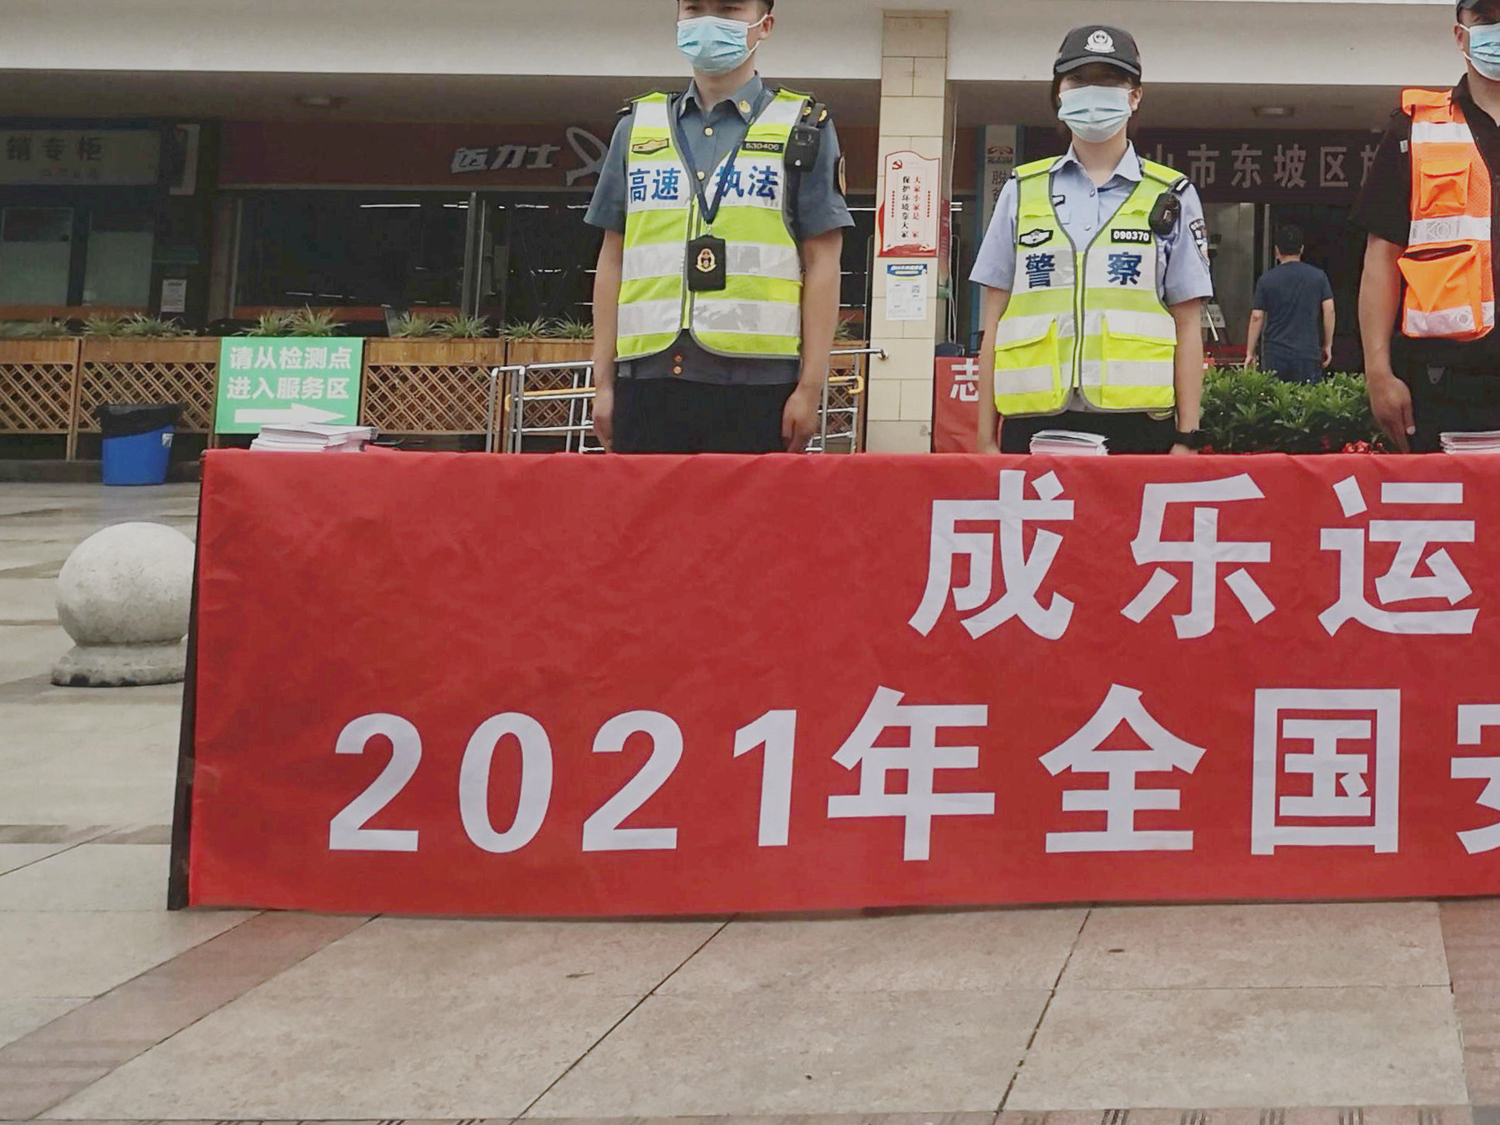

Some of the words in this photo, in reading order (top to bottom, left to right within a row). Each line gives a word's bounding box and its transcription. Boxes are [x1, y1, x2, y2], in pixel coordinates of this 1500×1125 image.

[229, 345, 353, 371] 请从检测点
[226, 376, 351, 401] 进入服务区
[949, 358, 980, 402] 志
